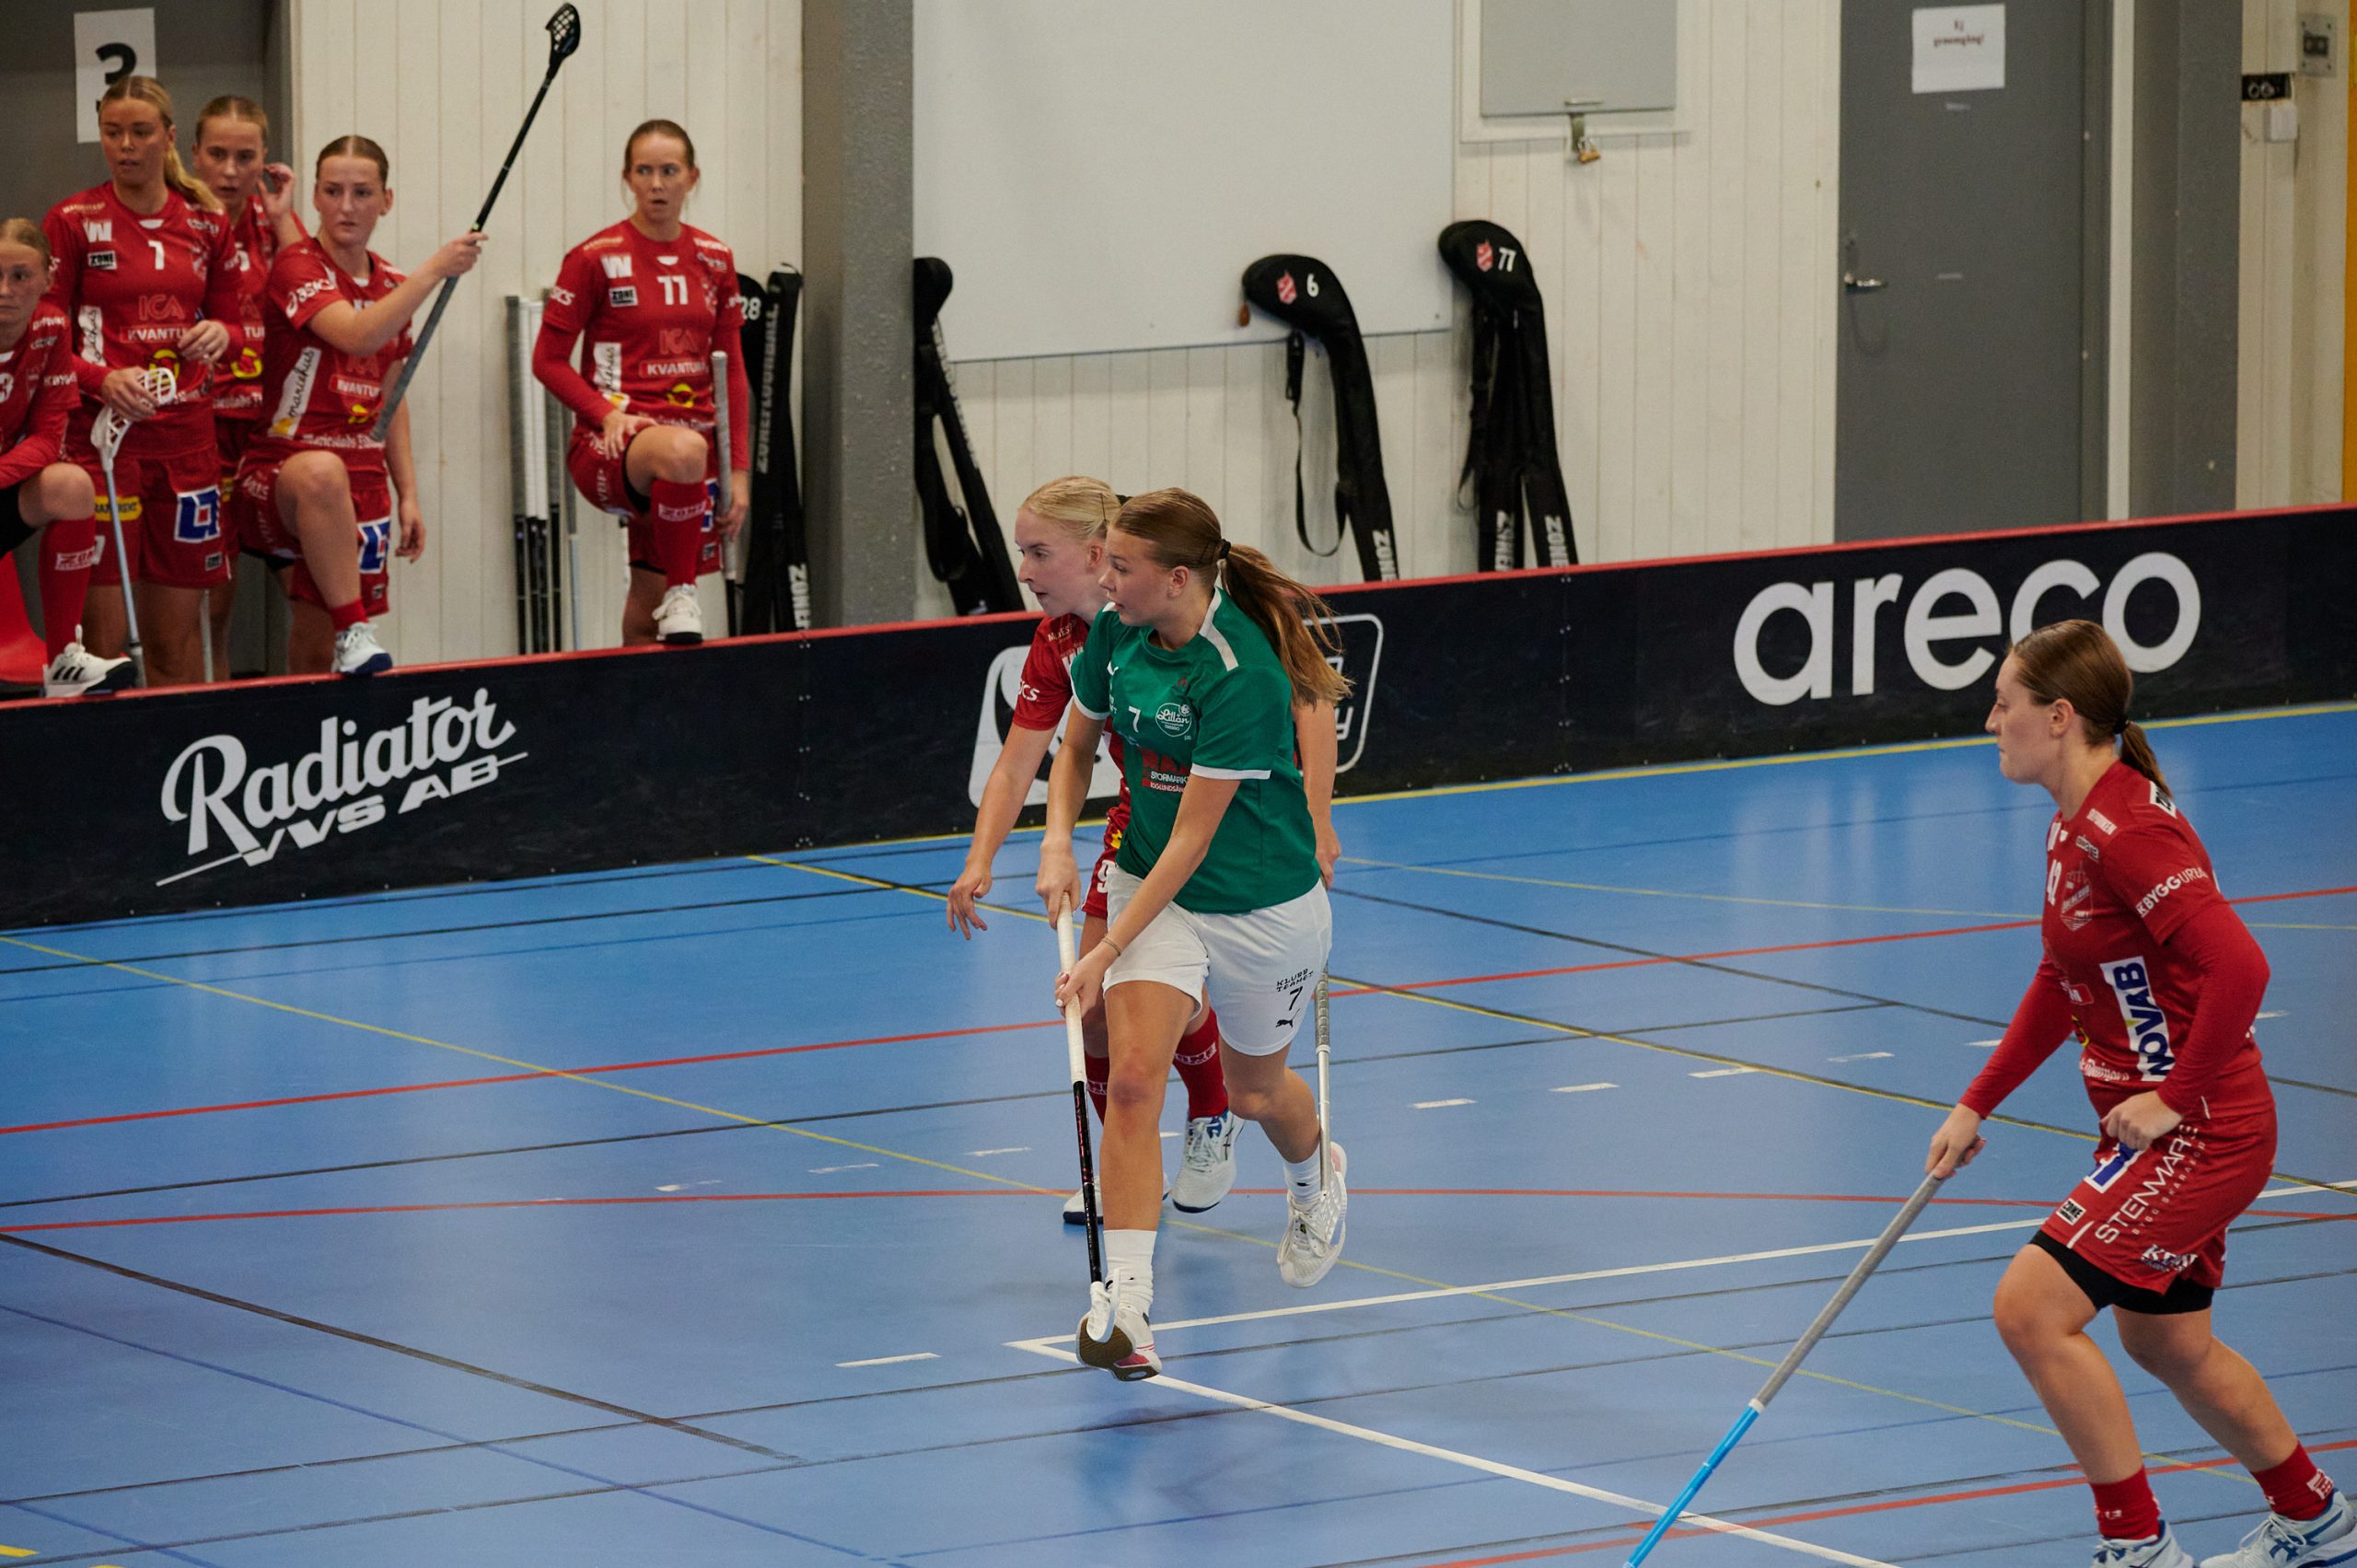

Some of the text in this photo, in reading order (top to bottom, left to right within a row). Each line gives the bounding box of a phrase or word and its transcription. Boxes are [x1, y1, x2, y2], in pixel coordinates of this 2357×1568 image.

[147, 240, 165, 270] 1
[1498, 247, 1516, 273] 77
[657, 275, 689, 306] 11
[1306, 273, 1319, 297] 6
[138, 294, 185, 320] ICA
[740, 296, 761, 321] 28
[128, 326, 187, 341] KVANTU
[1734, 552, 2200, 706] areco
[1128, 705, 1141, 733] 7
[1156, 708, 1190, 725] Lillån
[160, 688, 517, 855] Radiator
[242, 754, 499, 866] VVS AB
[1276, 968, 1308, 986] KLUBB
[1276, 970, 1314, 993] TEAMET
[1289, 985, 1303, 1011] 7
[2113, 961, 2176, 1076] NOVAB
